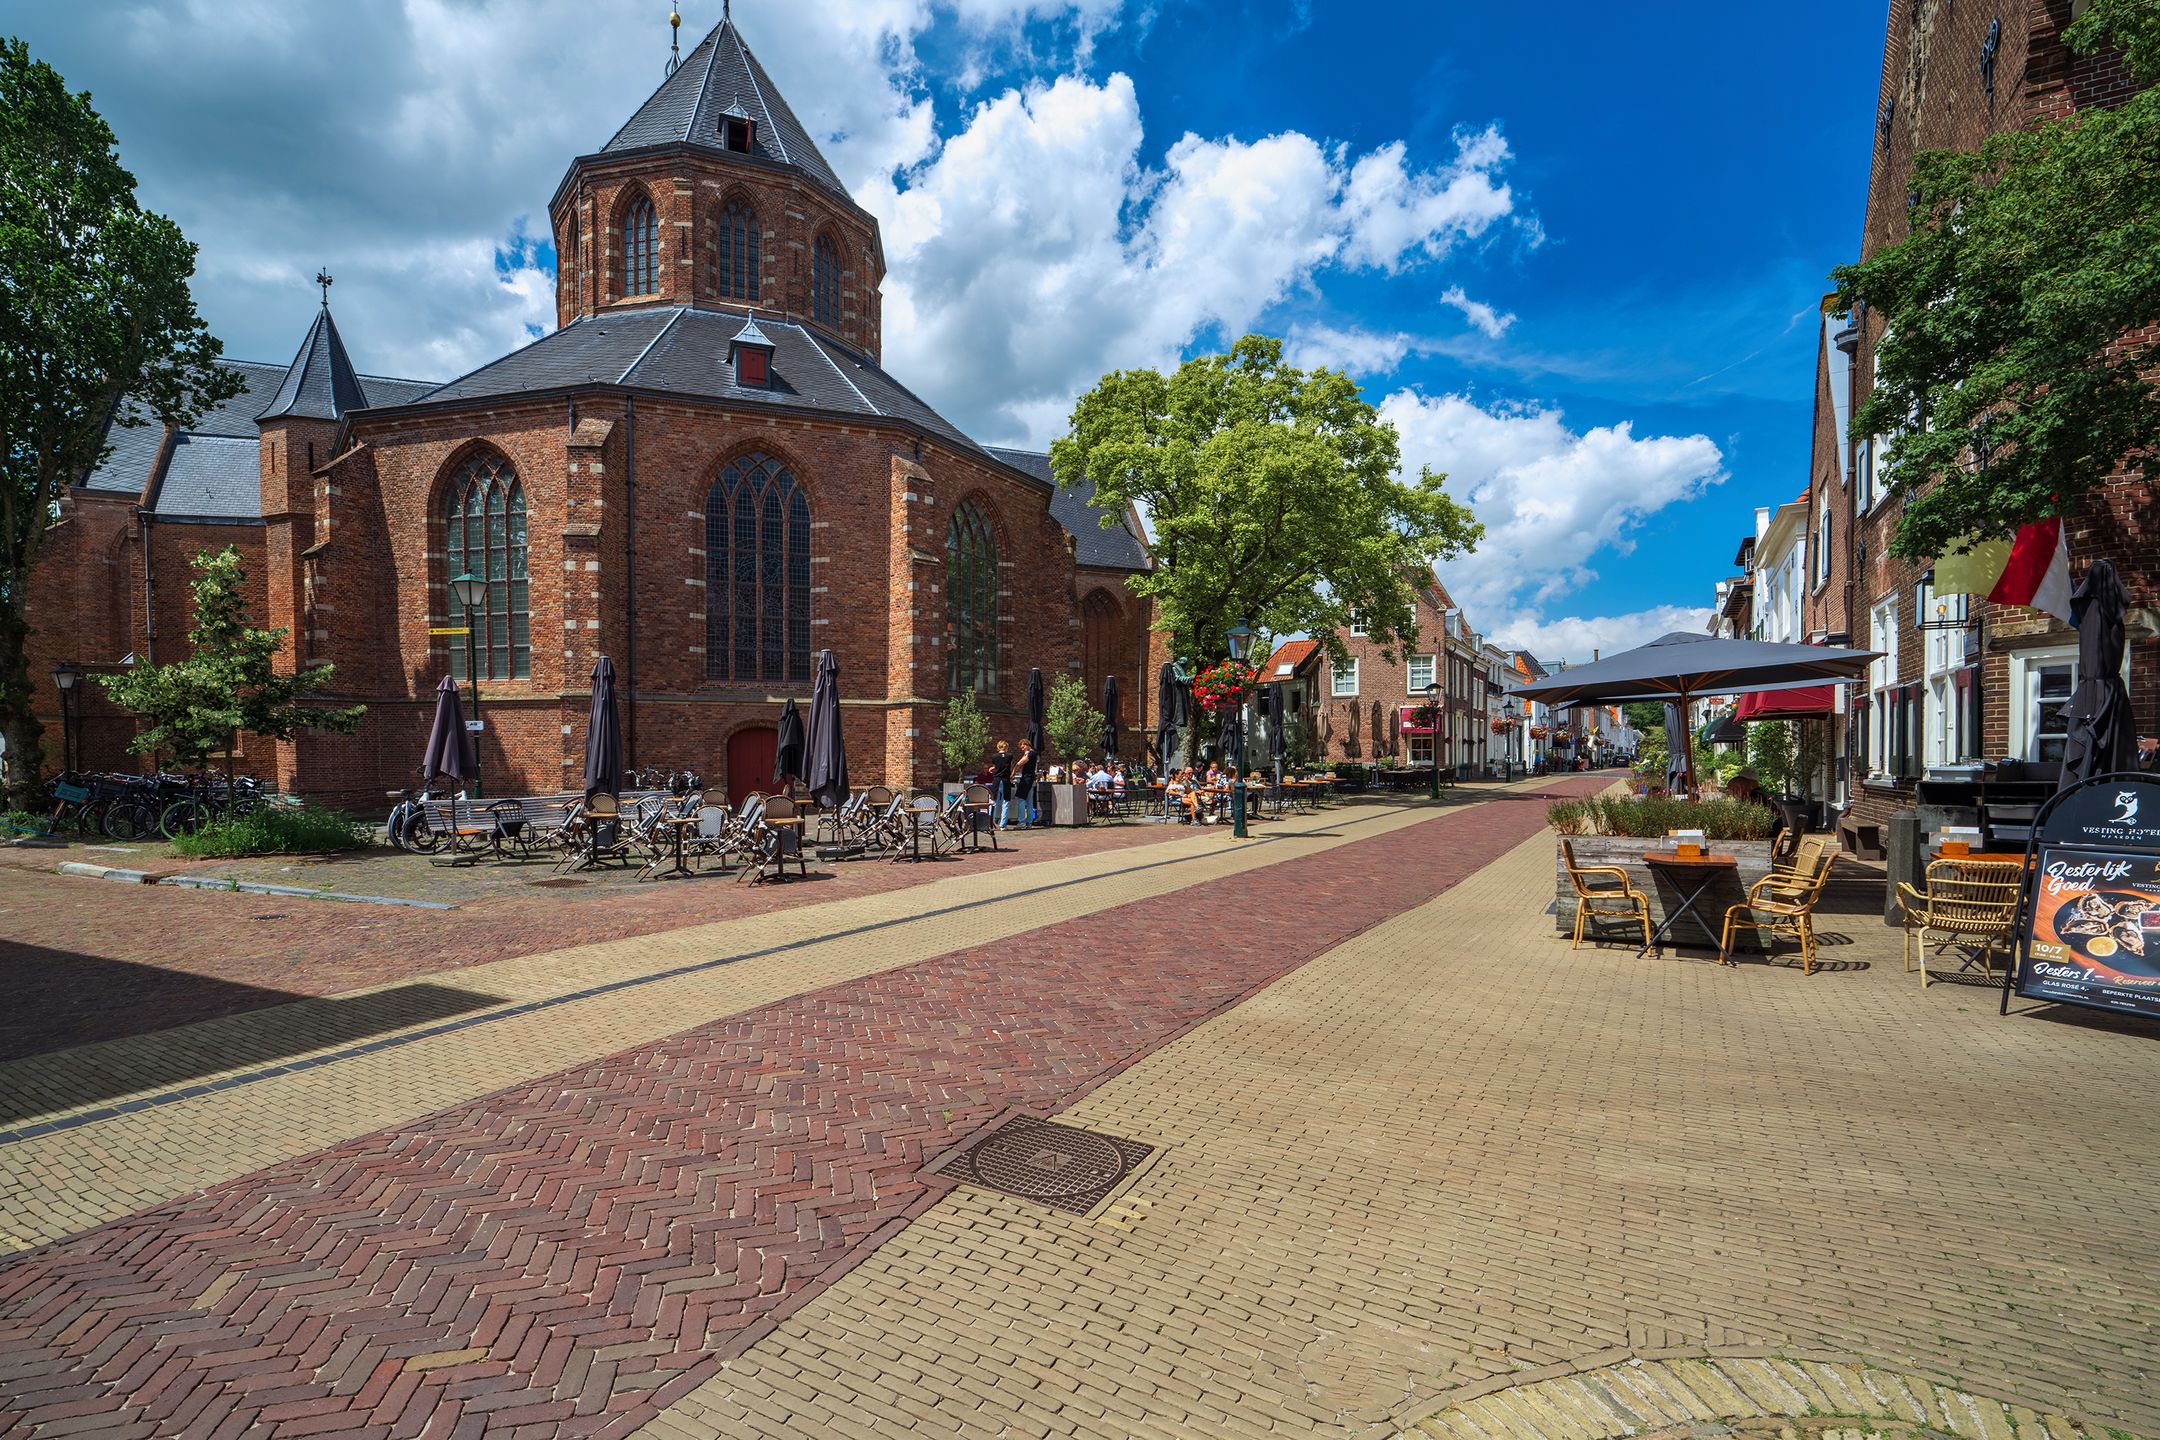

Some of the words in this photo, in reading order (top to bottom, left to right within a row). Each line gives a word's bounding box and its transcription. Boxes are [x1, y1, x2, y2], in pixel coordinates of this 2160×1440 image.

[2082, 826, 2124, 835] VESTING
[2047, 860, 2132, 881] Oesterlijk
[2047, 876, 2095, 896] Goed
[2035, 943, 2063, 954] 10/7
[2033, 962, 2081, 979] Oesters
[2102, 989, 2134, 998] BEPERKTE
